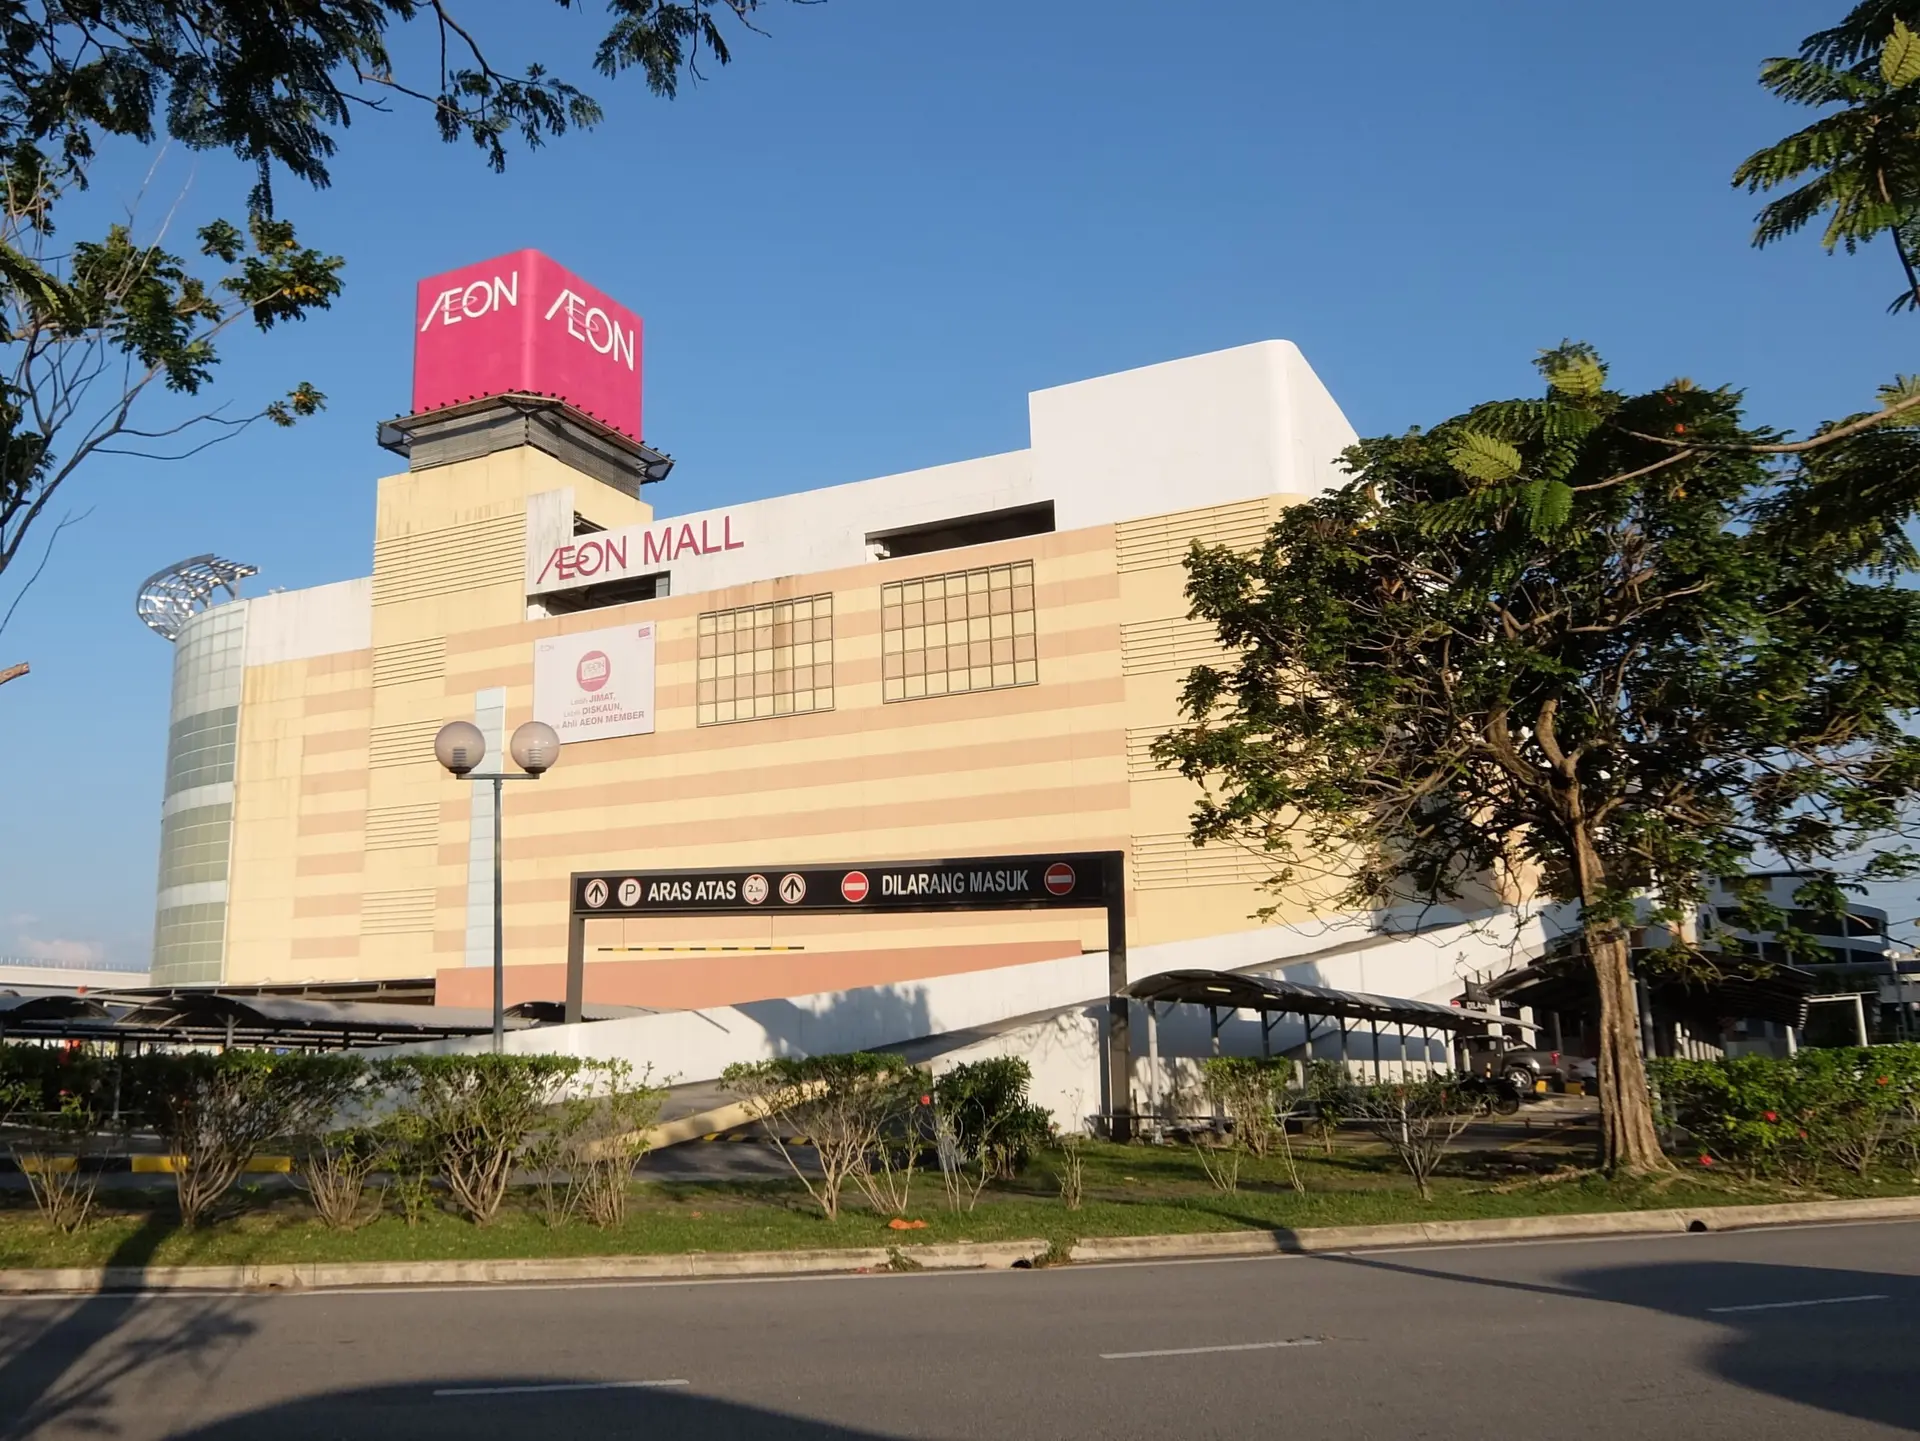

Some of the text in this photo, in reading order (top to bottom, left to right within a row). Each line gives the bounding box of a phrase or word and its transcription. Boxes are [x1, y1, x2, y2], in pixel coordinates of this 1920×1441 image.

[644, 516, 744, 565] MALL
[589, 692, 616, 703] JIMAT,
[580, 716, 604, 726] AEON
[605, 711, 645, 722] MEMBER
[582, 703, 623, 715] DISKAUN,
[648, 880, 737, 901] ARAS ATAS
[882, 870, 1029, 895] DILARANG MASUK
[625, 884, 636, 904] P
